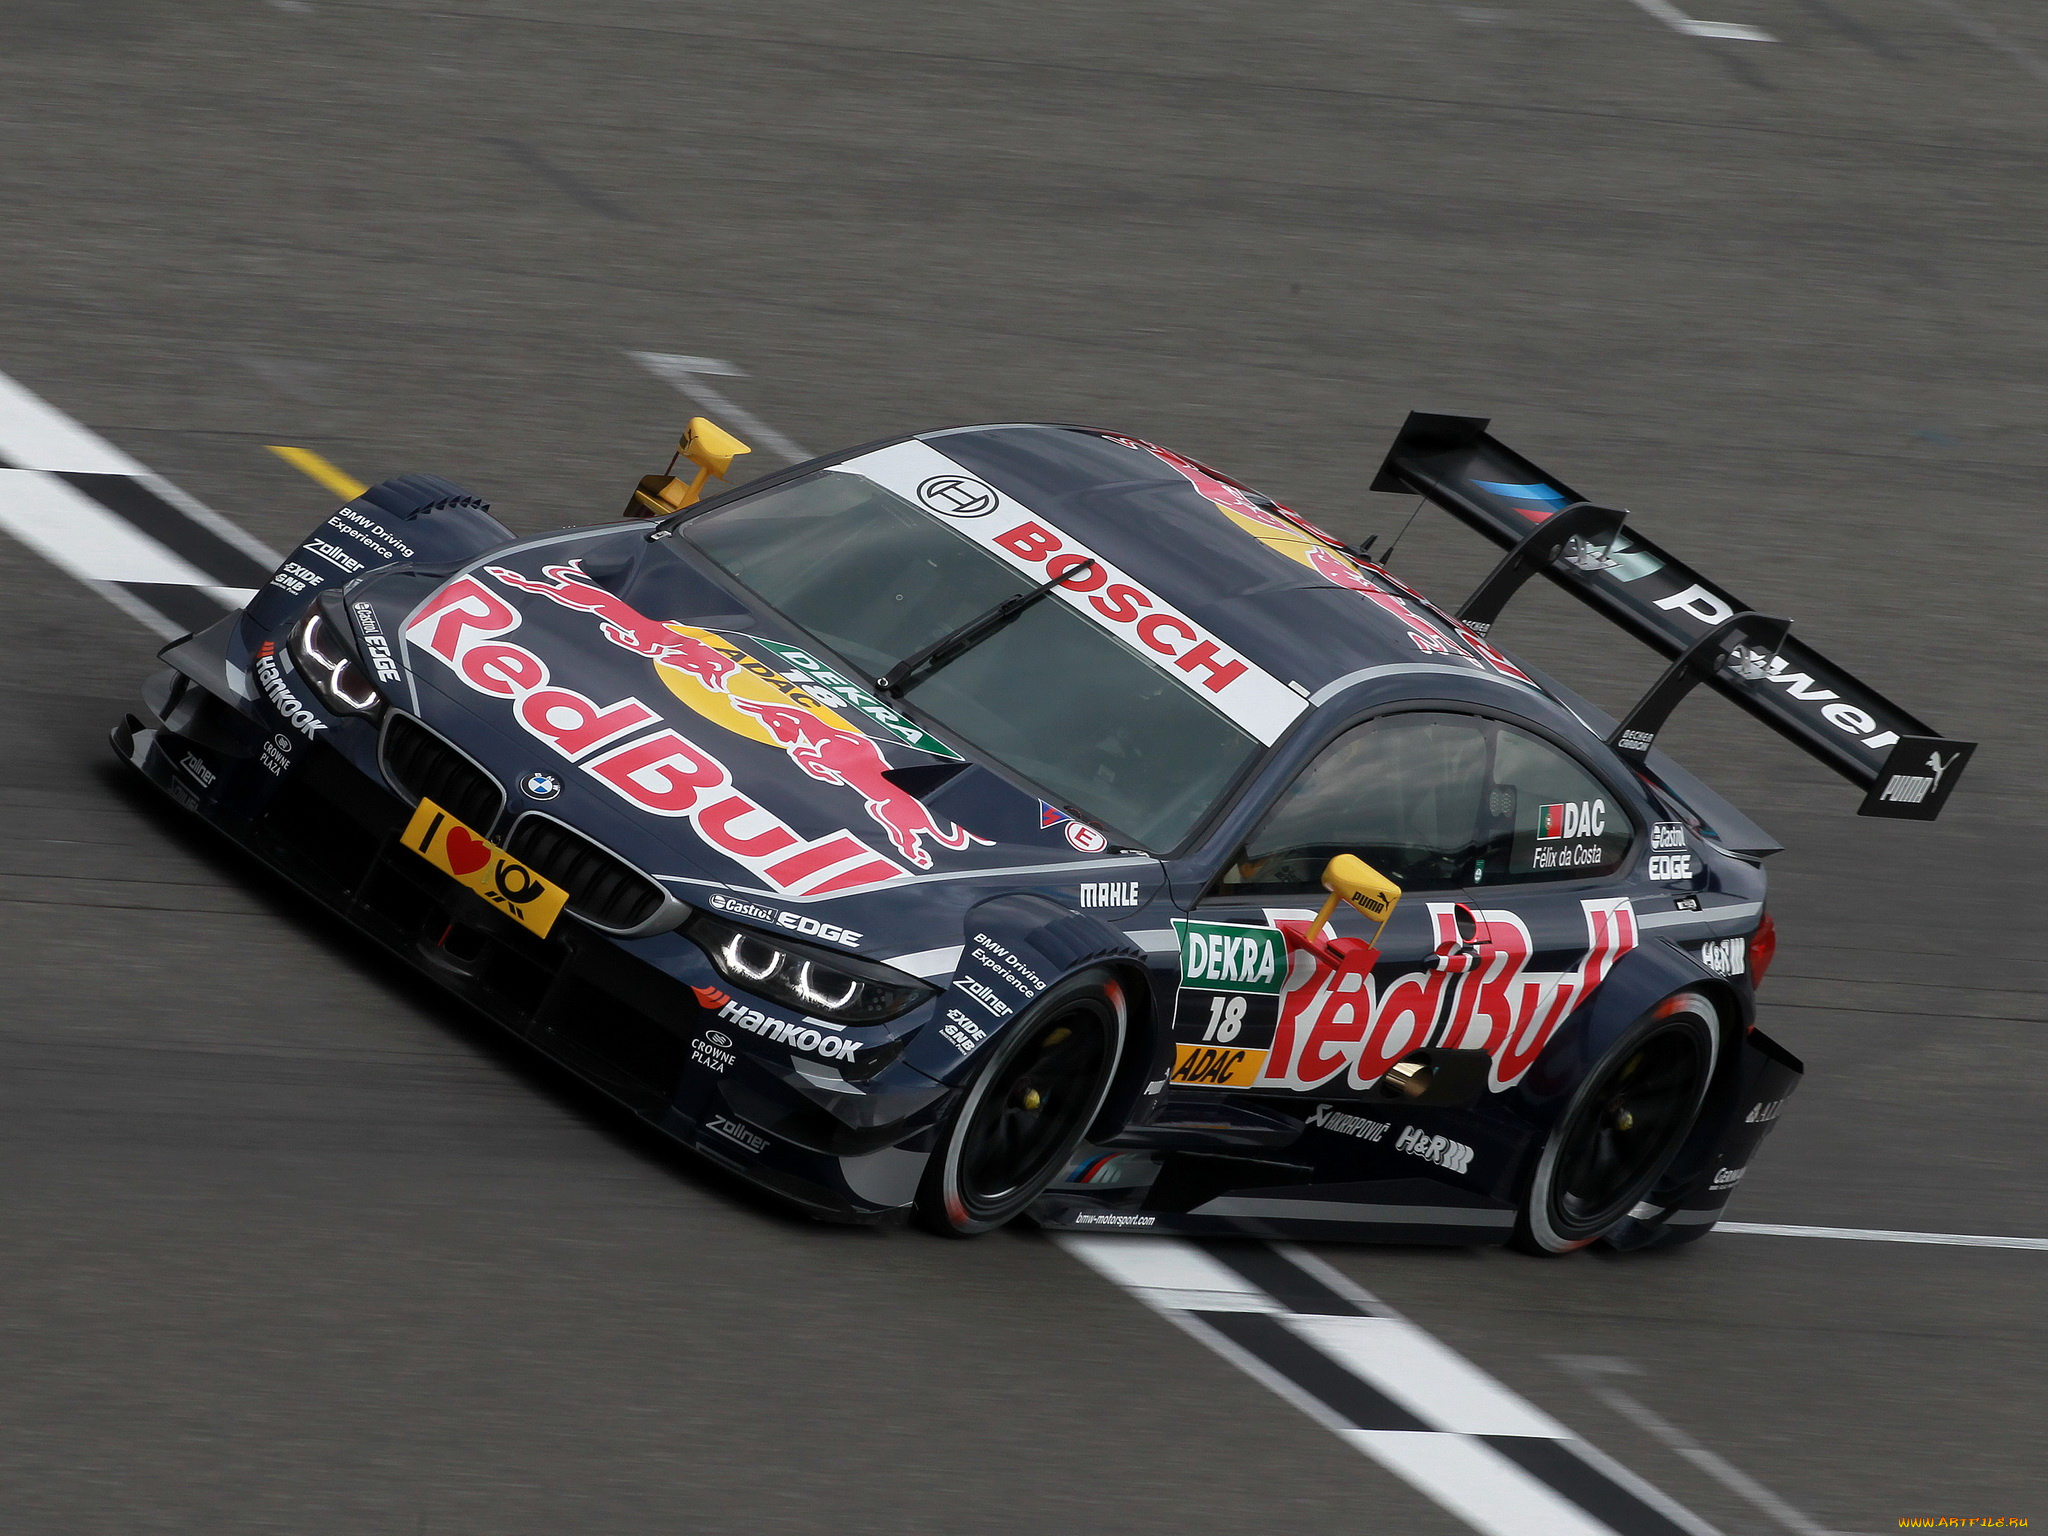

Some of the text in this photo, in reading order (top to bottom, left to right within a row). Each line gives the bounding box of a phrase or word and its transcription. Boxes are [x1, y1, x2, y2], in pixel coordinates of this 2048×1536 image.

[327, 516, 393, 560] Experience
[339, 507, 415, 559] BMW Driving
[283, 562, 325, 586] EXIDE
[303, 538, 365, 574] Zollner
[275, 573, 306, 592] GNB
[992, 521, 1249, 693] BOSCH
[357, 609, 402, 683] Castrol EDGE
[715, 647, 821, 708] ADAC
[780, 668, 848, 709] 18
[782, 651, 923, 744] DEKRA
[259, 753, 282, 777] PLAZA
[263, 741, 291, 770] CROWNE
[1880, 774, 1934, 803] PUMA
[418, 812, 445, 854] I
[1563, 798, 1606, 839] DAC
[1659, 826, 1686, 848] Castrol
[1533, 844, 1602, 868] Félix da Costa
[1649, 855, 1693, 881] EDGE
[1080, 881, 1139, 908] MAHLE
[1352, 891, 1384, 914] PUMA
[725, 898, 864, 948] Castrol EDGE
[971, 947, 1034, 999] Experience
[973, 932, 1047, 991] BMW Driving
[1188, 932, 1275, 984] DEKRA
[953, 975, 1013, 1018] Zollner
[944, 1024, 976, 1051] GNB
[946, 1008, 987, 1042] EXIDE
[1202, 996, 1247, 1044] 18
[691, 1038, 737, 1066] CROWNE
[691, 1050, 725, 1074] PLAZA
[1170, 1048, 1246, 1085] ADAC
[706, 1114, 771, 1154] Zollner
[1395, 1125, 1462, 1170] H&R
[1075, 1211, 1156, 1228] bmw-motorsport.com
